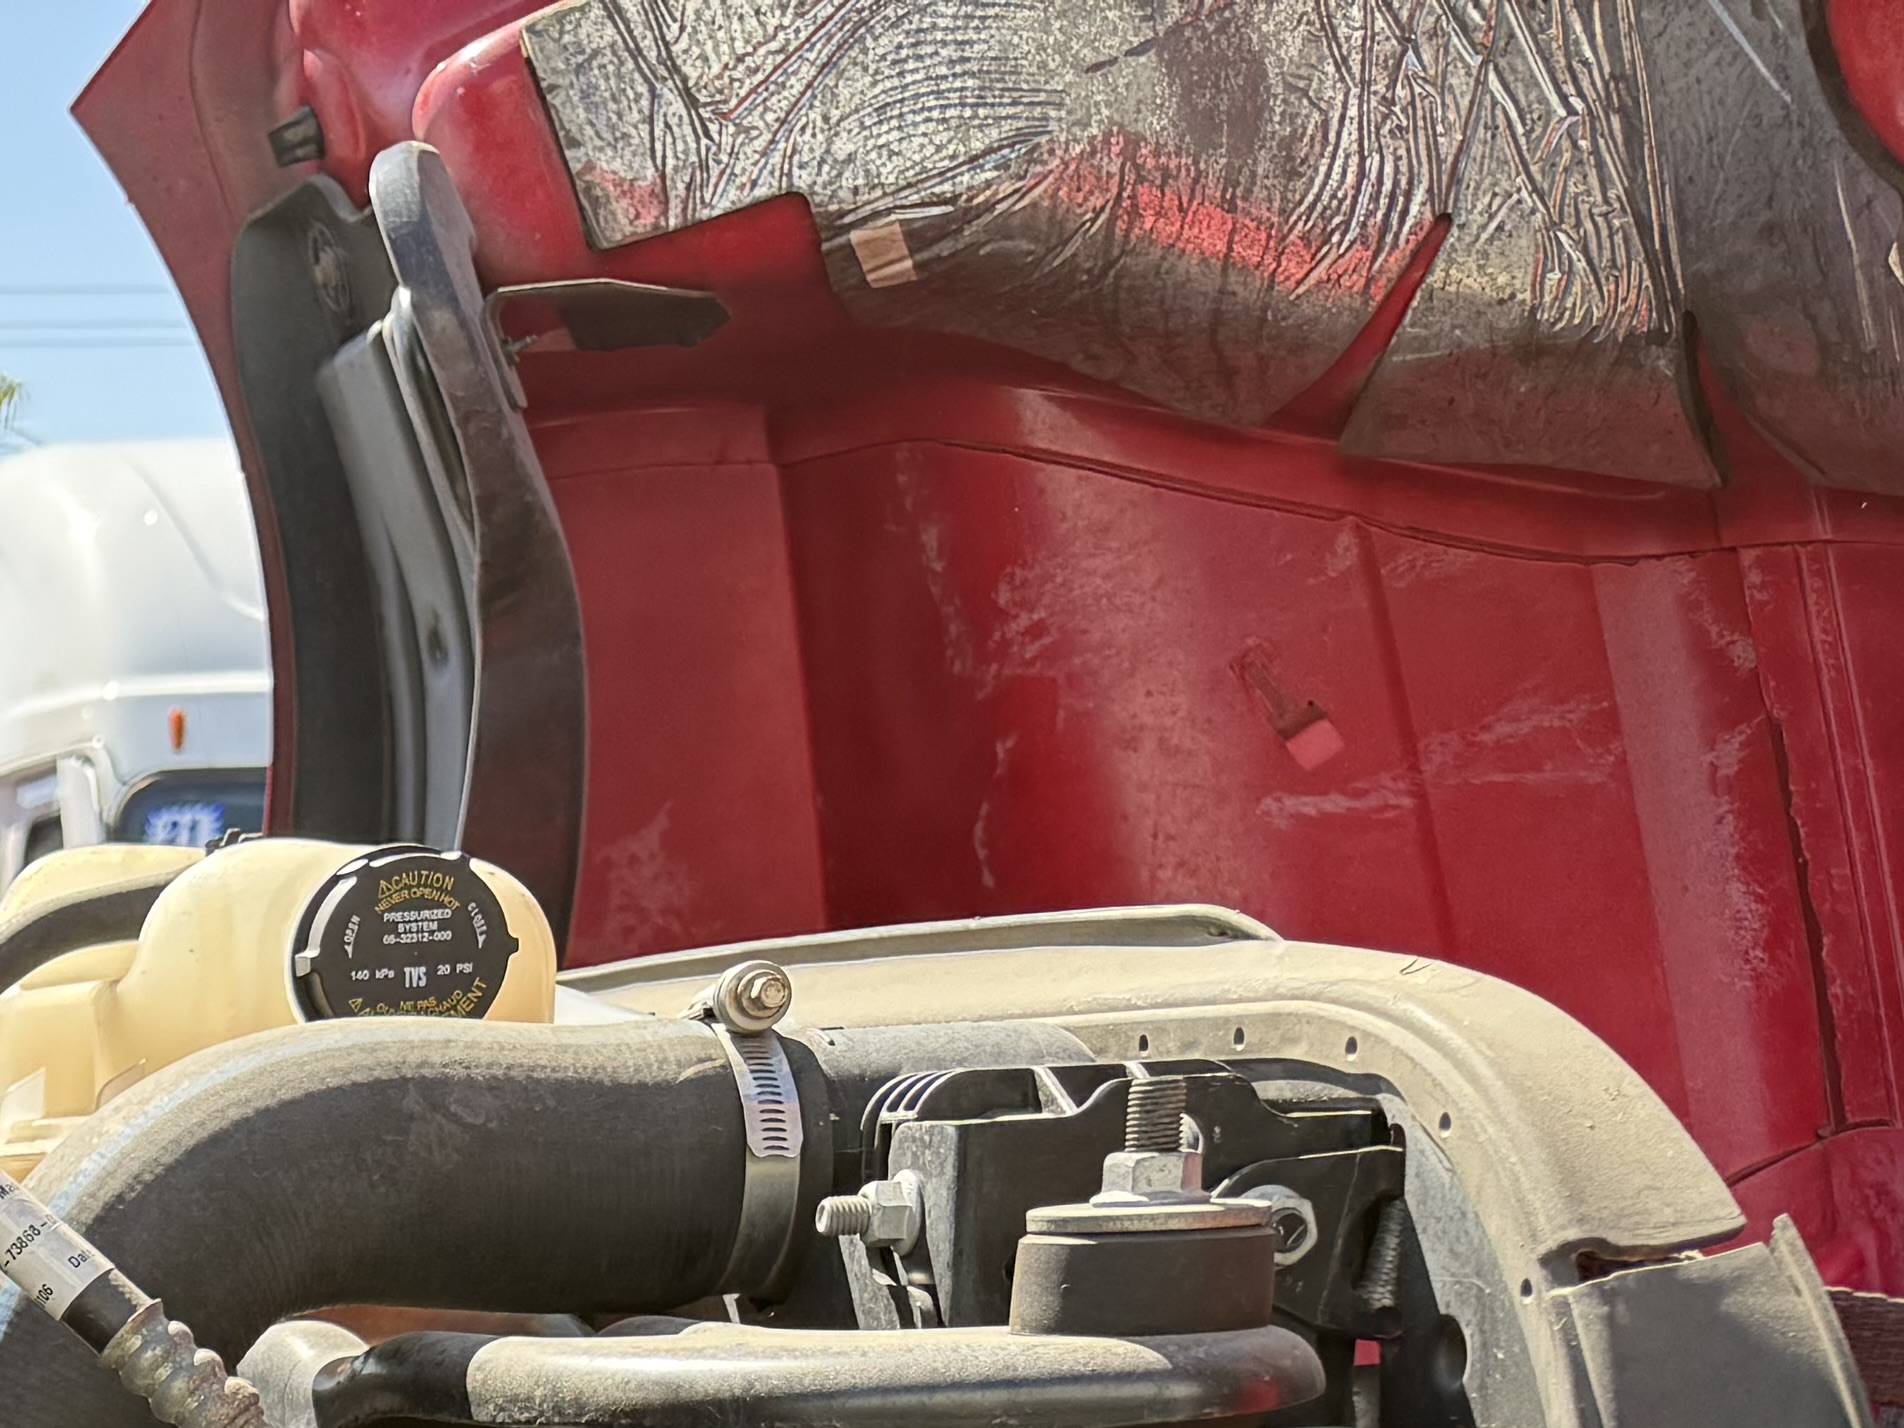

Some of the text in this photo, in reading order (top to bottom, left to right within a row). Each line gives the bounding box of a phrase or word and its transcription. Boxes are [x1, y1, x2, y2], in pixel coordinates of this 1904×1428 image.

[391, 870, 454, 891] CAUTION
[374, 887, 461, 914] NEVER OPEN HOT
[383, 908, 452, 922] PRESSURIZED
[344, 914, 360, 943] OPEN
[397, 921, 438, 933] SYSTEM
[350, 970, 370, 981] 140
[437, 962, 473, 976] 20 PSI
[403, 966, 427, 988] TVS
[416, 997, 436, 1010] PAS
